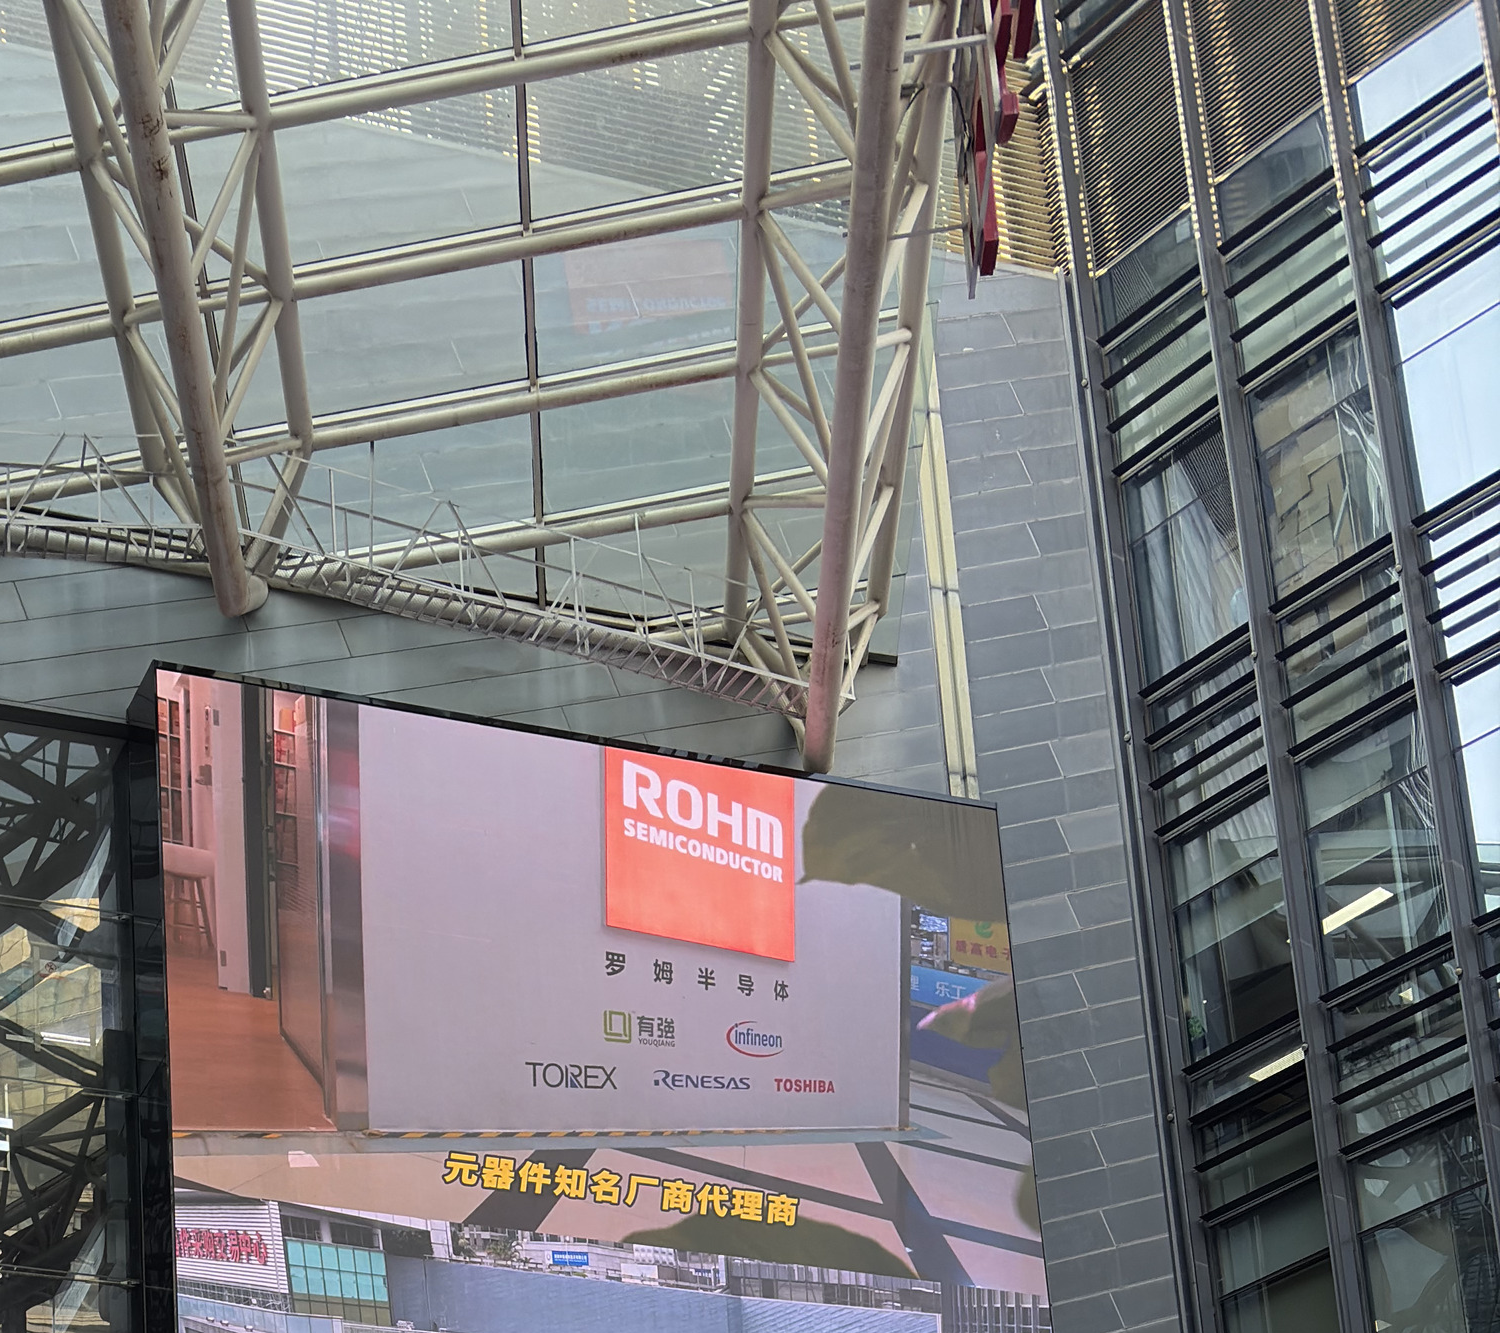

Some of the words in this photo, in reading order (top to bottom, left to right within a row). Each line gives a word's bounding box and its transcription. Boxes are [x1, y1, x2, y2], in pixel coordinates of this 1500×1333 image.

[623, 759, 783, 859] ROHM
[624, 818, 783, 883] SEMICONDUCTOR
[604, 950, 790, 1002] 罗姆半导体
[638, 1038, 676, 1048] YOUQIANG
[525, 1061, 617, 1089] TOREX
[653, 1069, 750, 1091] RENESAS
[774, 1077, 835, 1094] TOSHIBA
[442, 1148, 800, 1228] 元器件知名厂商代理商
